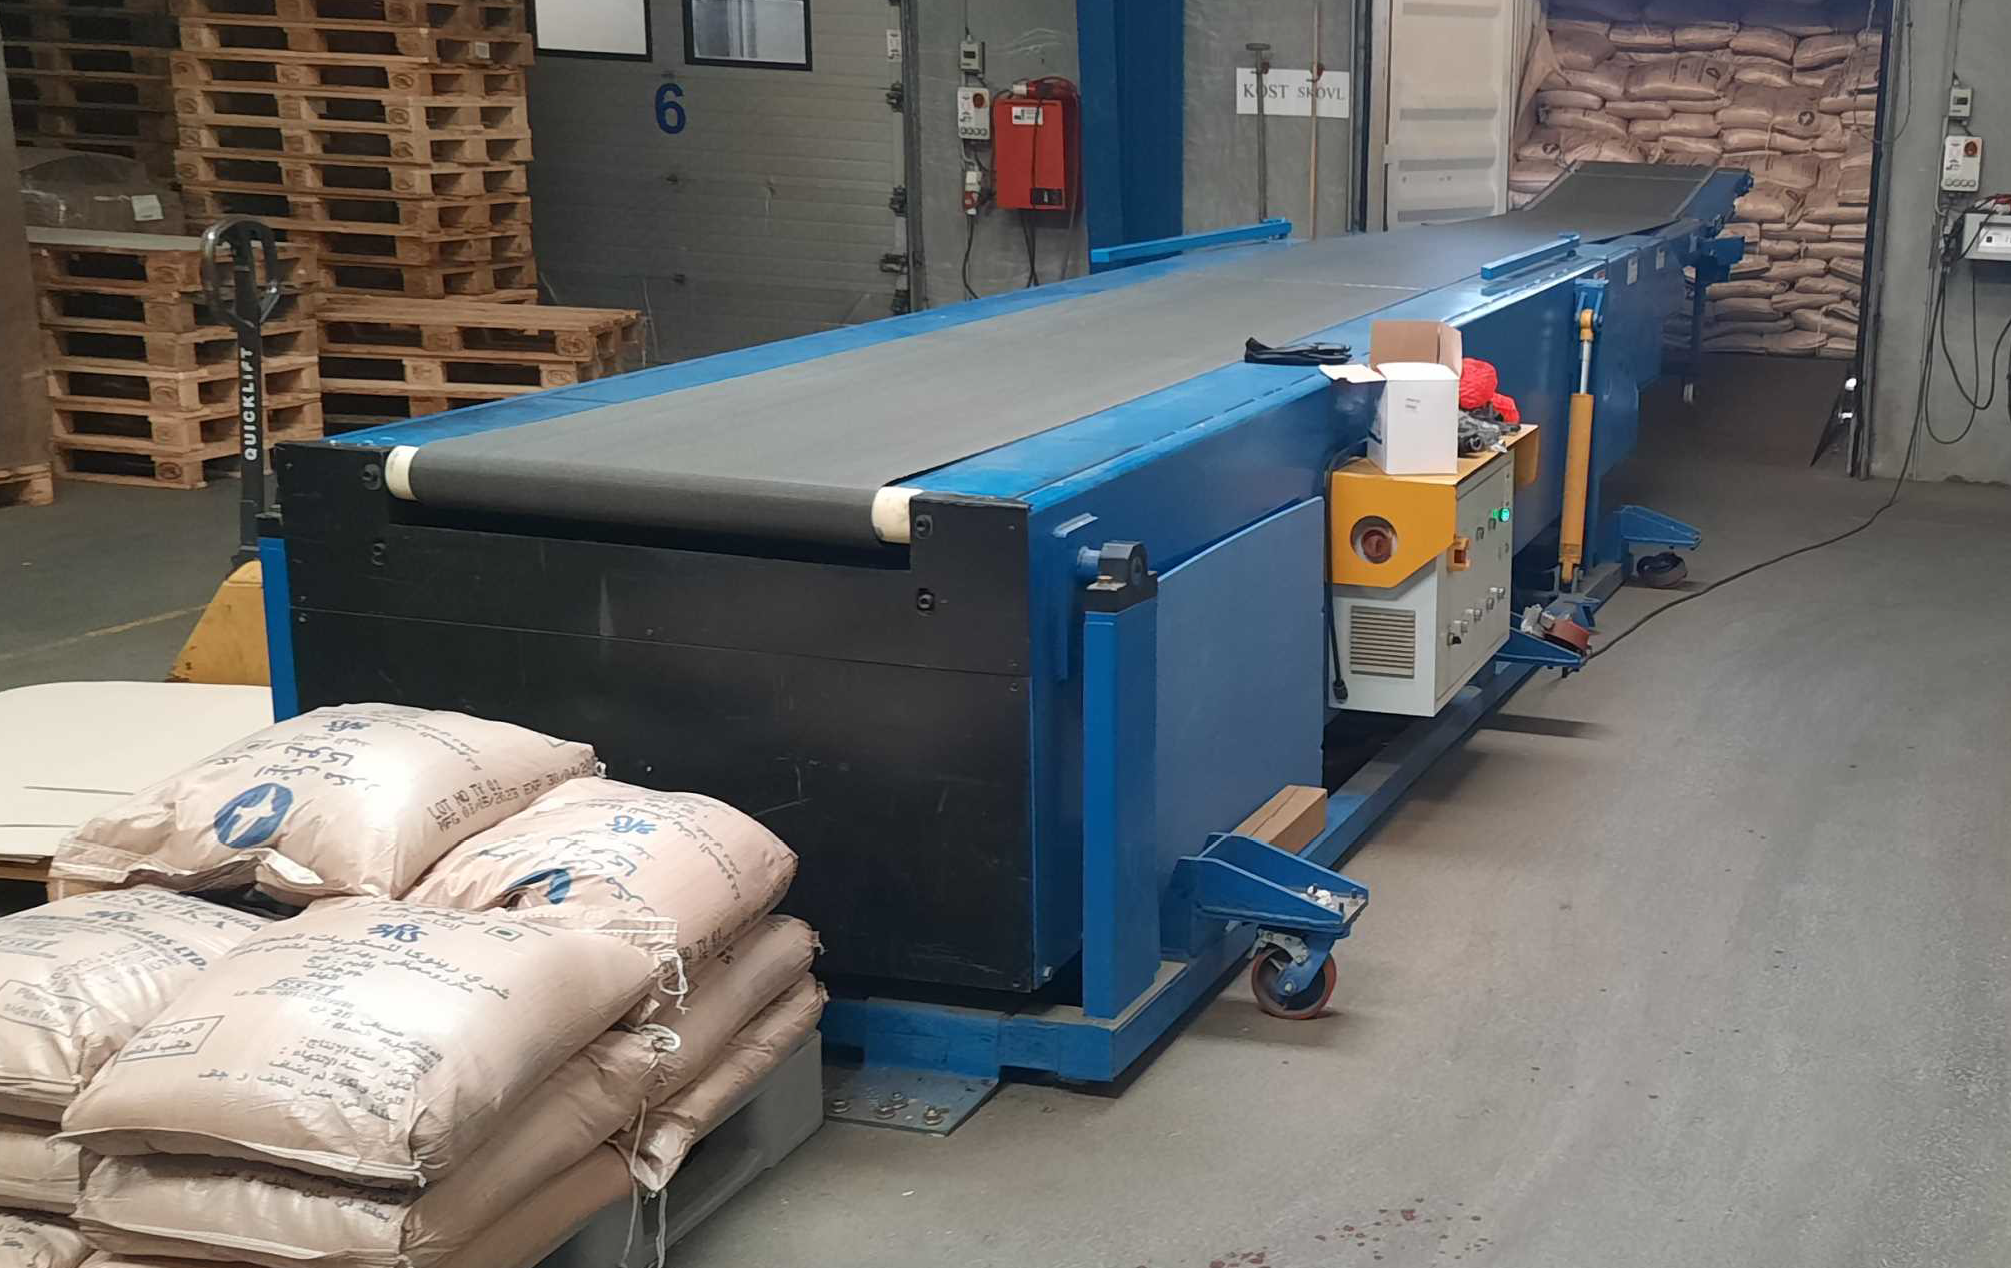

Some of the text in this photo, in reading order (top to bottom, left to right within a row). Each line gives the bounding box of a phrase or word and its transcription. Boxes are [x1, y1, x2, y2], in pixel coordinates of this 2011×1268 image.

[655, 83, 686, 134] 6
[1297, 86, 1346, 100] SKOVL
[240, 347, 258, 460] QUICKLIFT
[427, 798, 453, 820] LOT
[469, 783, 485, 797] TY
[485, 778, 502, 792] 01
[436, 811, 462, 833] MFG
[522, 778, 543, 797] EXP
[173, 946, 208, 971] LTD.
[404, 948, 461, 973] رينوكا
